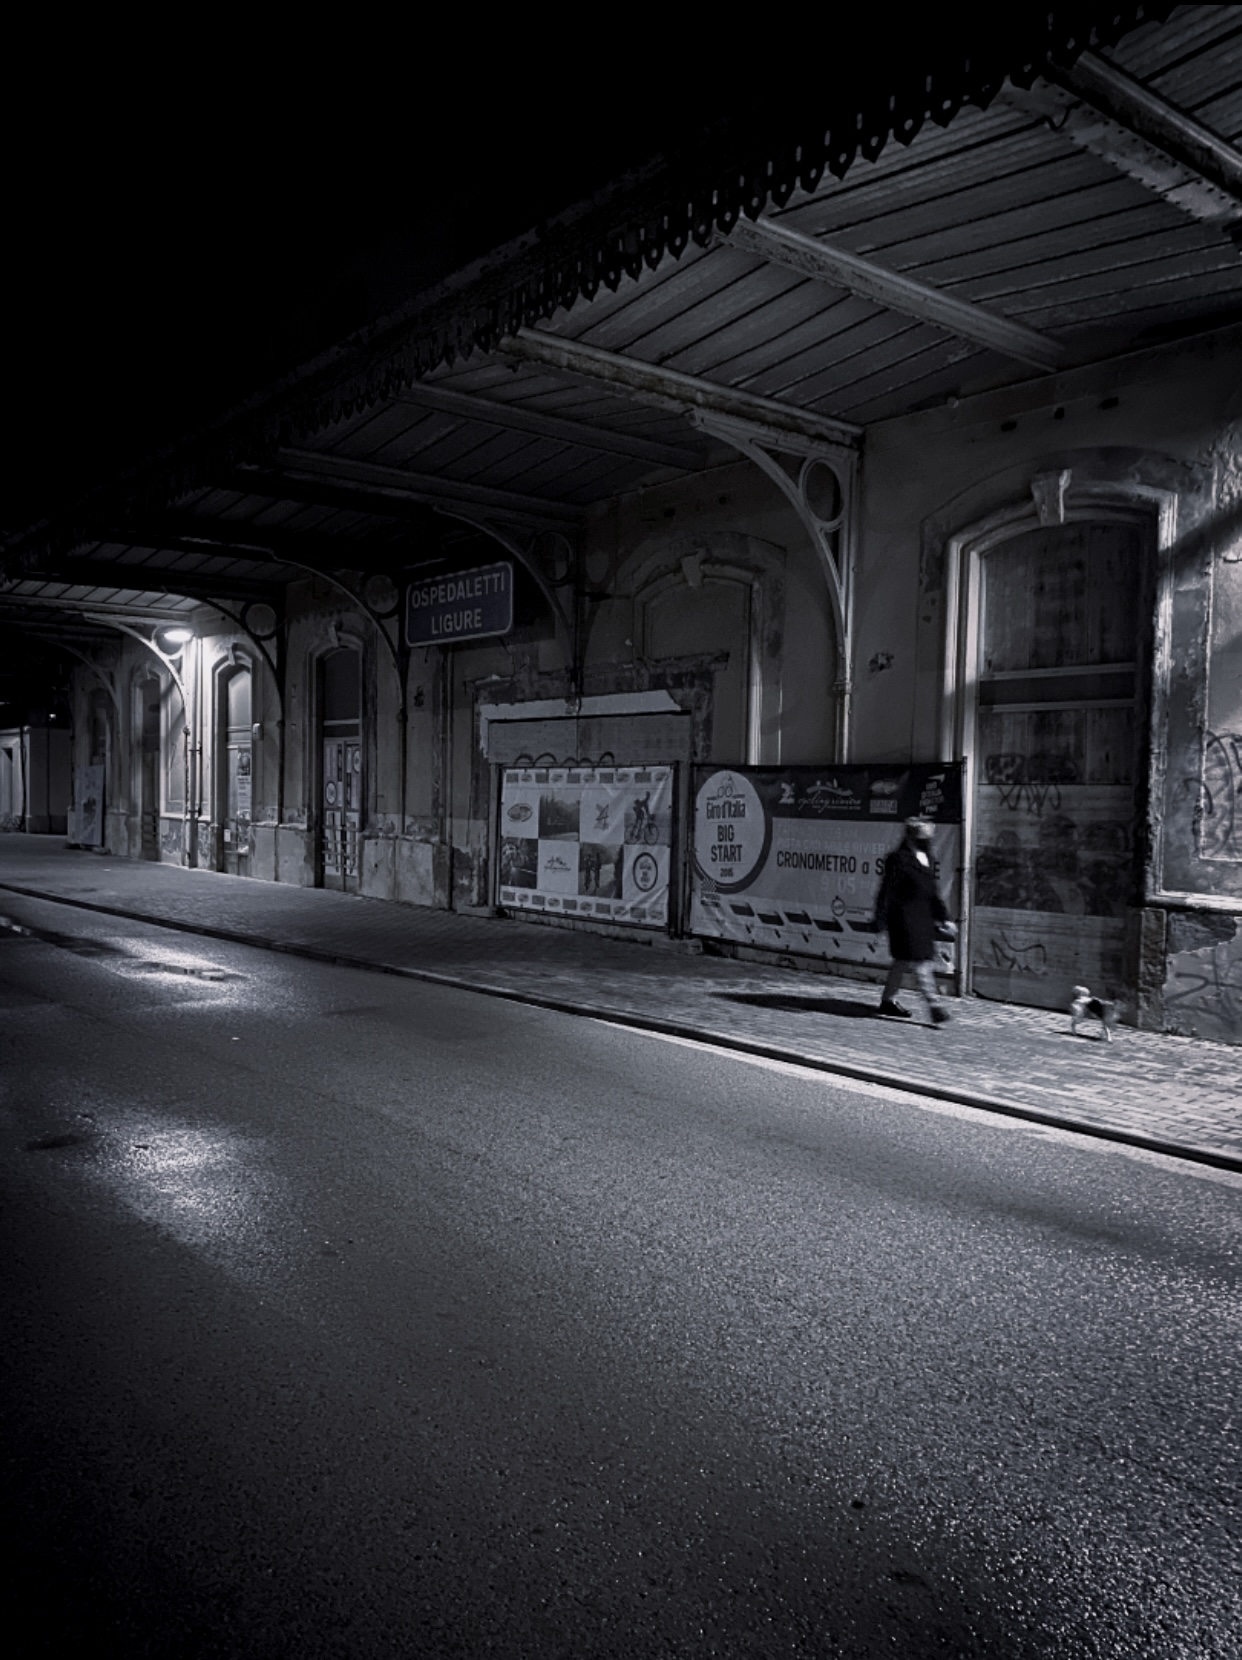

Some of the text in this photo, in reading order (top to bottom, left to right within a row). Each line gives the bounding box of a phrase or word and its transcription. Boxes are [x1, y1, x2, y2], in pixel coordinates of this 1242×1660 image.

[411, 571, 505, 608] OSPEDALETTI
[431, 608, 483, 635] LIGURE
[717, 824, 735, 842] BIG
[710, 844, 743, 862] START
[776, 850, 857, 873] CRONOMETRO
[862, 861, 870, 875] a
